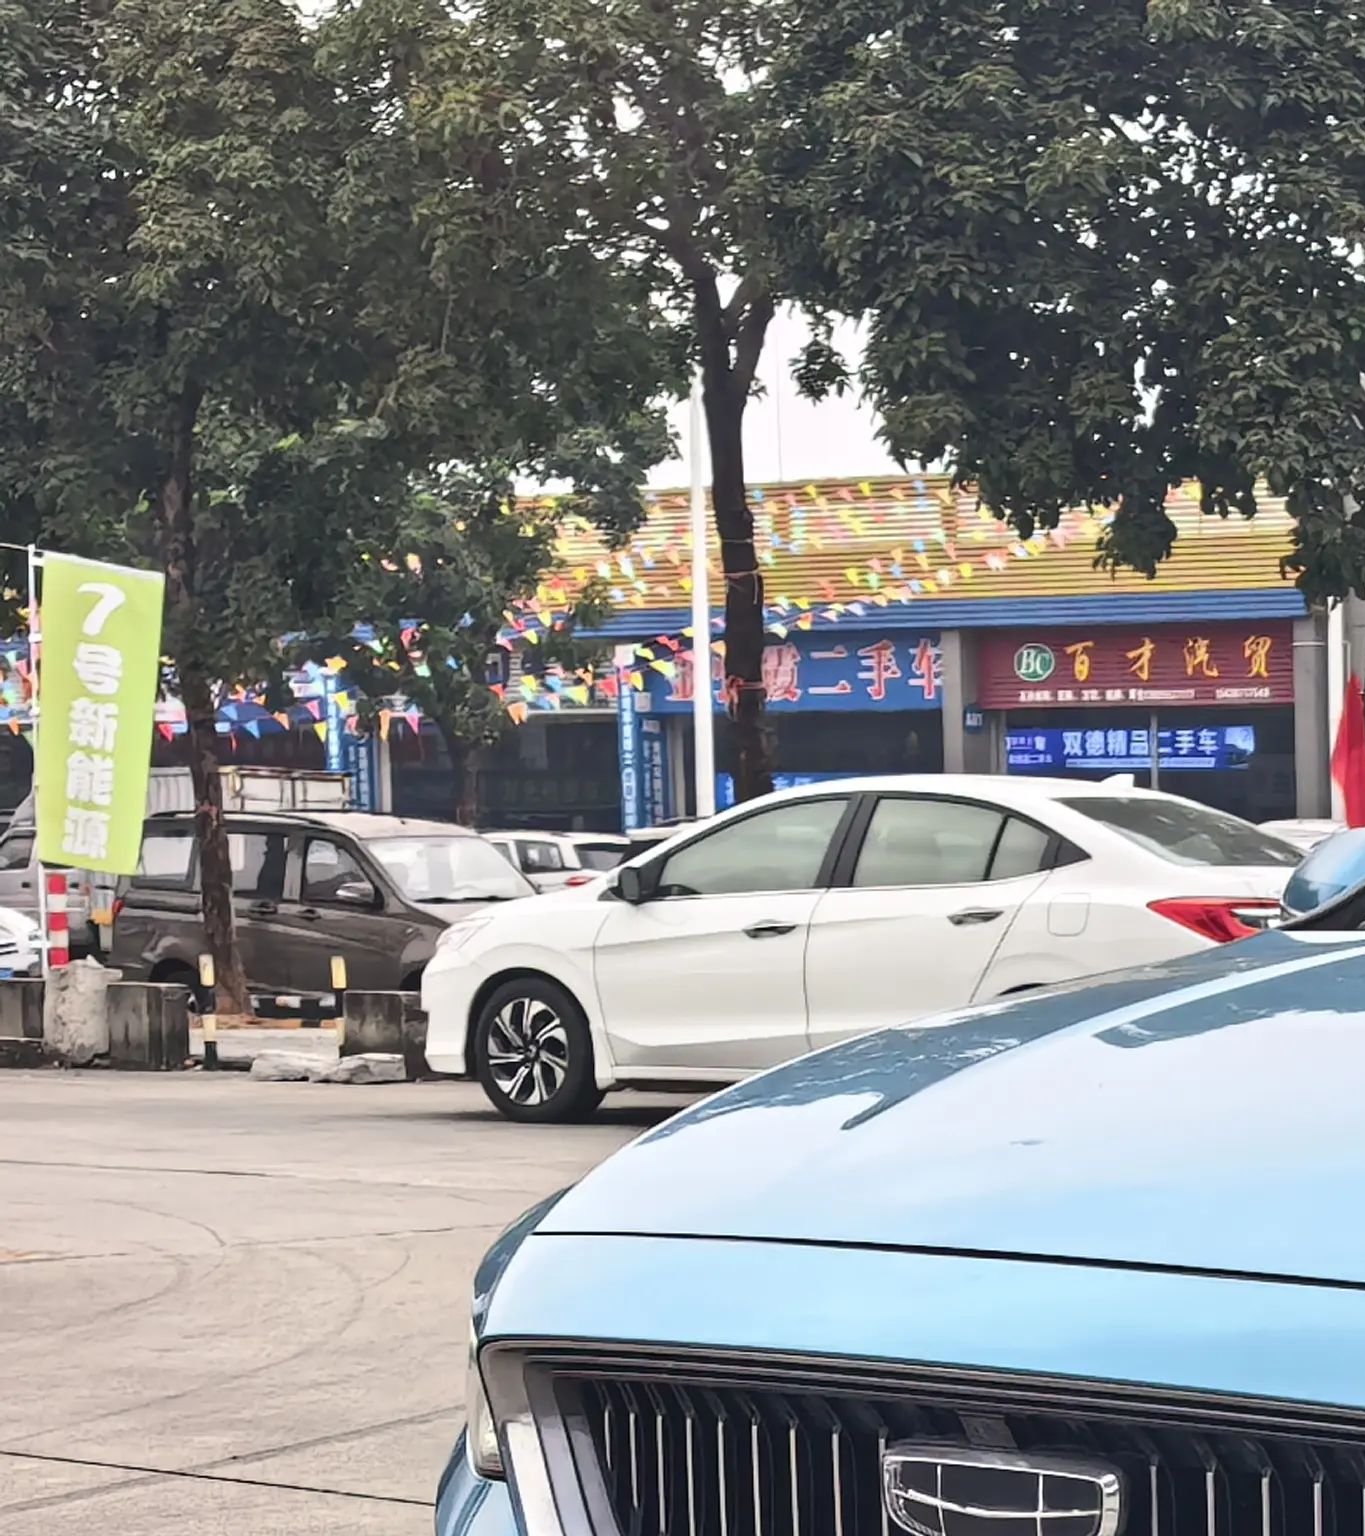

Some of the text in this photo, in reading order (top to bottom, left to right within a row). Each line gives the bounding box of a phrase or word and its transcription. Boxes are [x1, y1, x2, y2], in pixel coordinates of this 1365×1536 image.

[63, 583, 126, 860] 7号新能源
[1064, 635, 1273, 682] 百才汽贸
